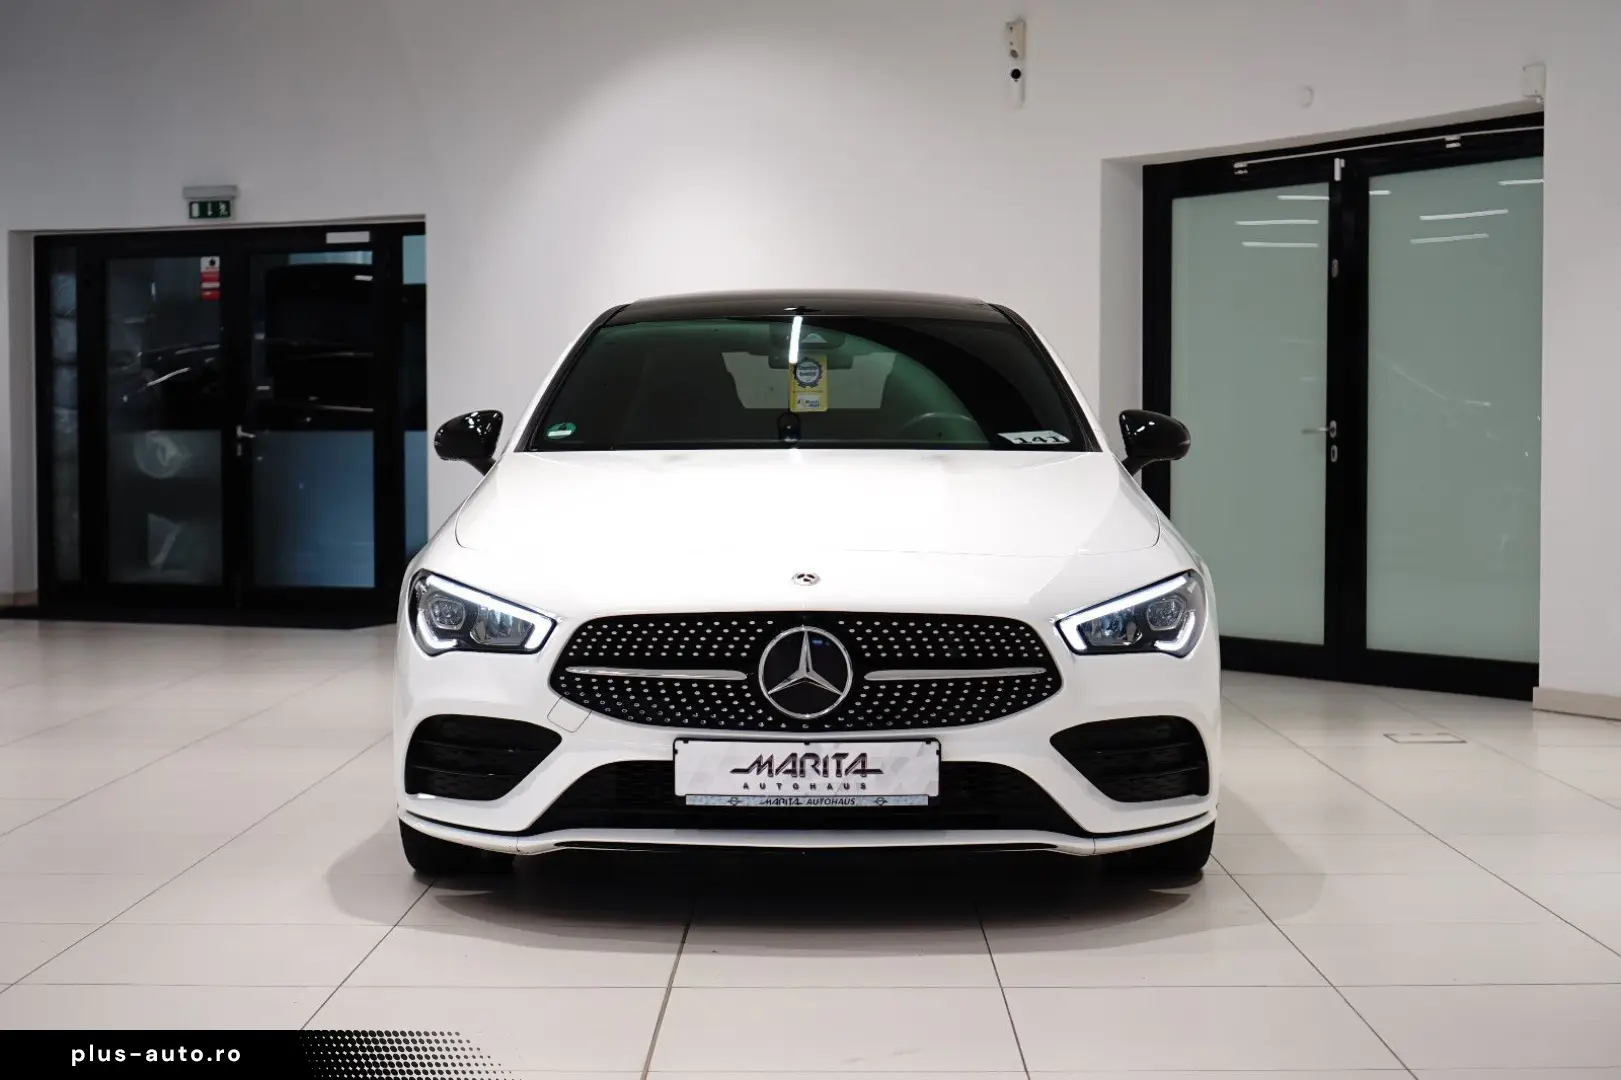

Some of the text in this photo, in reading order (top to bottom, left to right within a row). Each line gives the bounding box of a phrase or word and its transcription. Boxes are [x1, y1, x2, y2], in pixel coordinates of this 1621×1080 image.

[729, 752, 884, 778] MARITA
[743, 782, 867, 791] AUTOHAUS
[759, 797, 856, 806] MARITA AUTOHAUS
